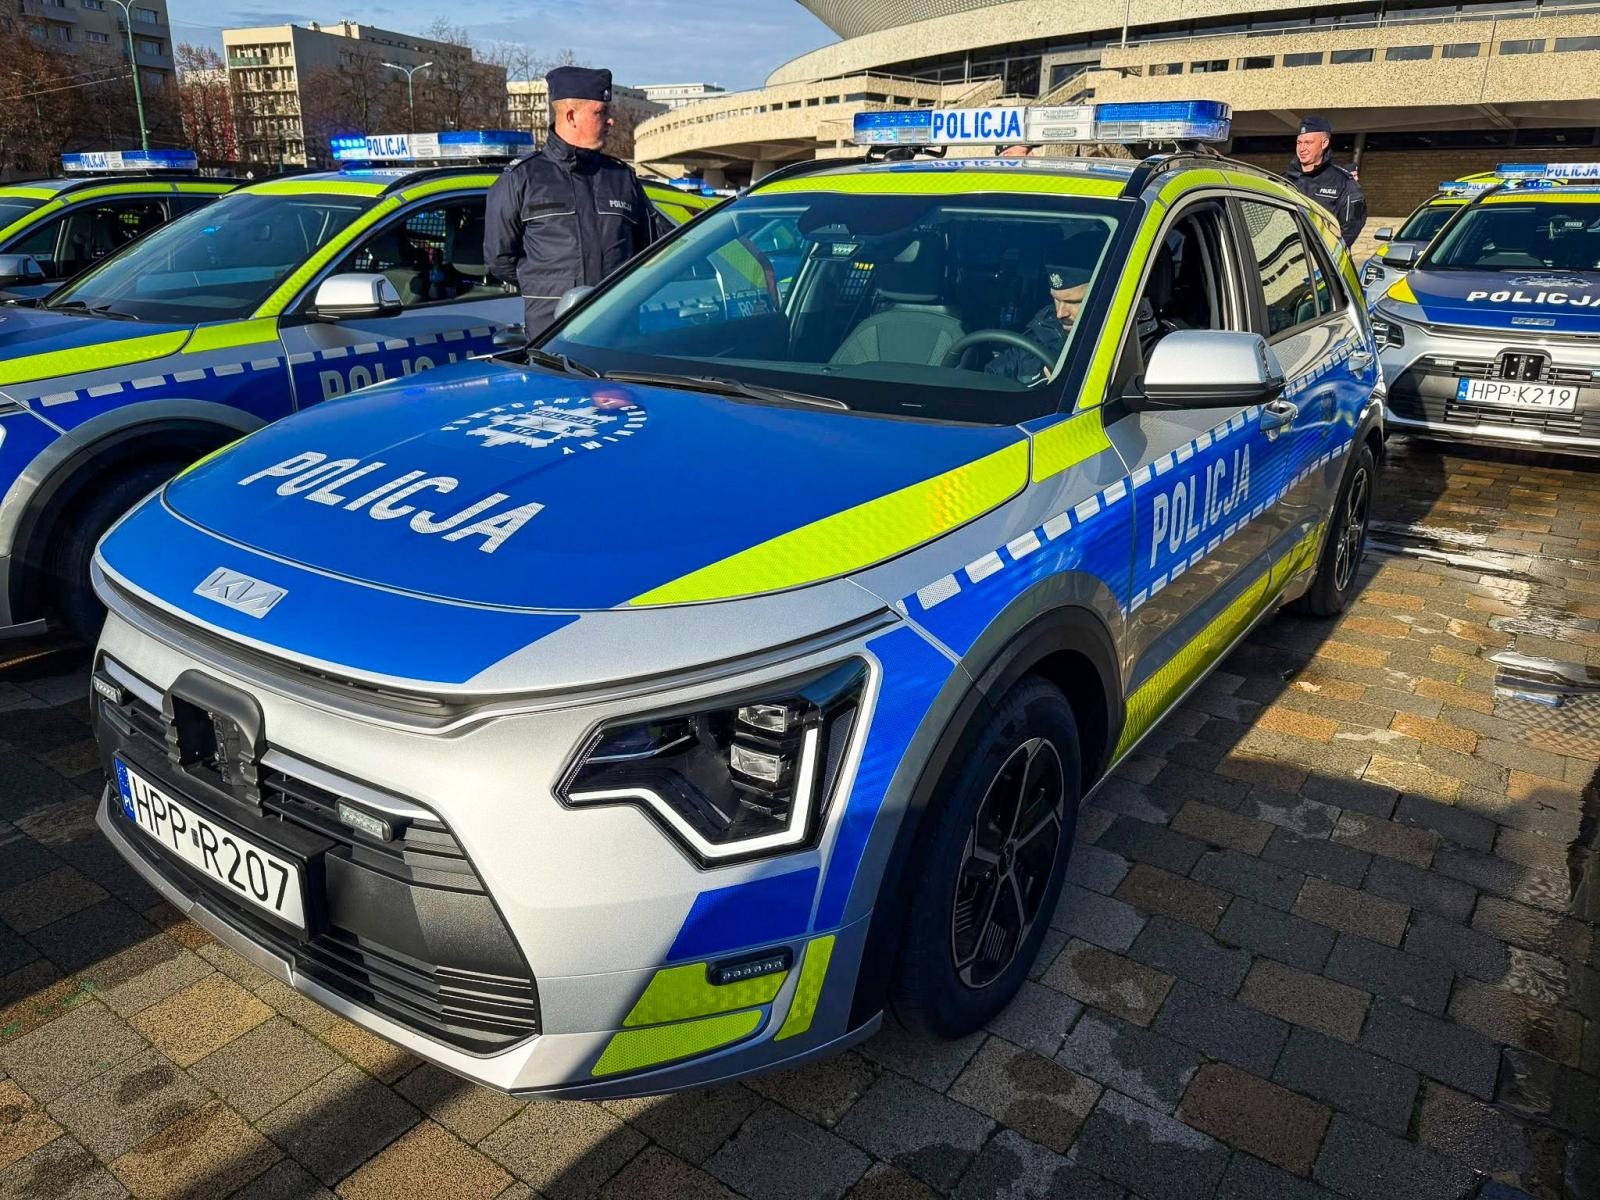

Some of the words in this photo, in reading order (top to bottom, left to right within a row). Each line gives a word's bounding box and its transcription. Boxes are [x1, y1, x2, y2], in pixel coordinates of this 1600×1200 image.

[933, 109, 1022, 139] POLICJA
[366, 135, 408, 157] POLICJA
[1546, 163, 1599, 177] POLICJA
[1472, 382, 1511, 400] HPP
[1517, 386, 1571, 406] K219
[237, 450, 546, 554] POLICJA
[1150, 443, 1251, 569] POLICJA
[198, 569, 284, 615] KIA
[131, 774, 188, 850] HPP
[195, 820, 290, 912] R207
